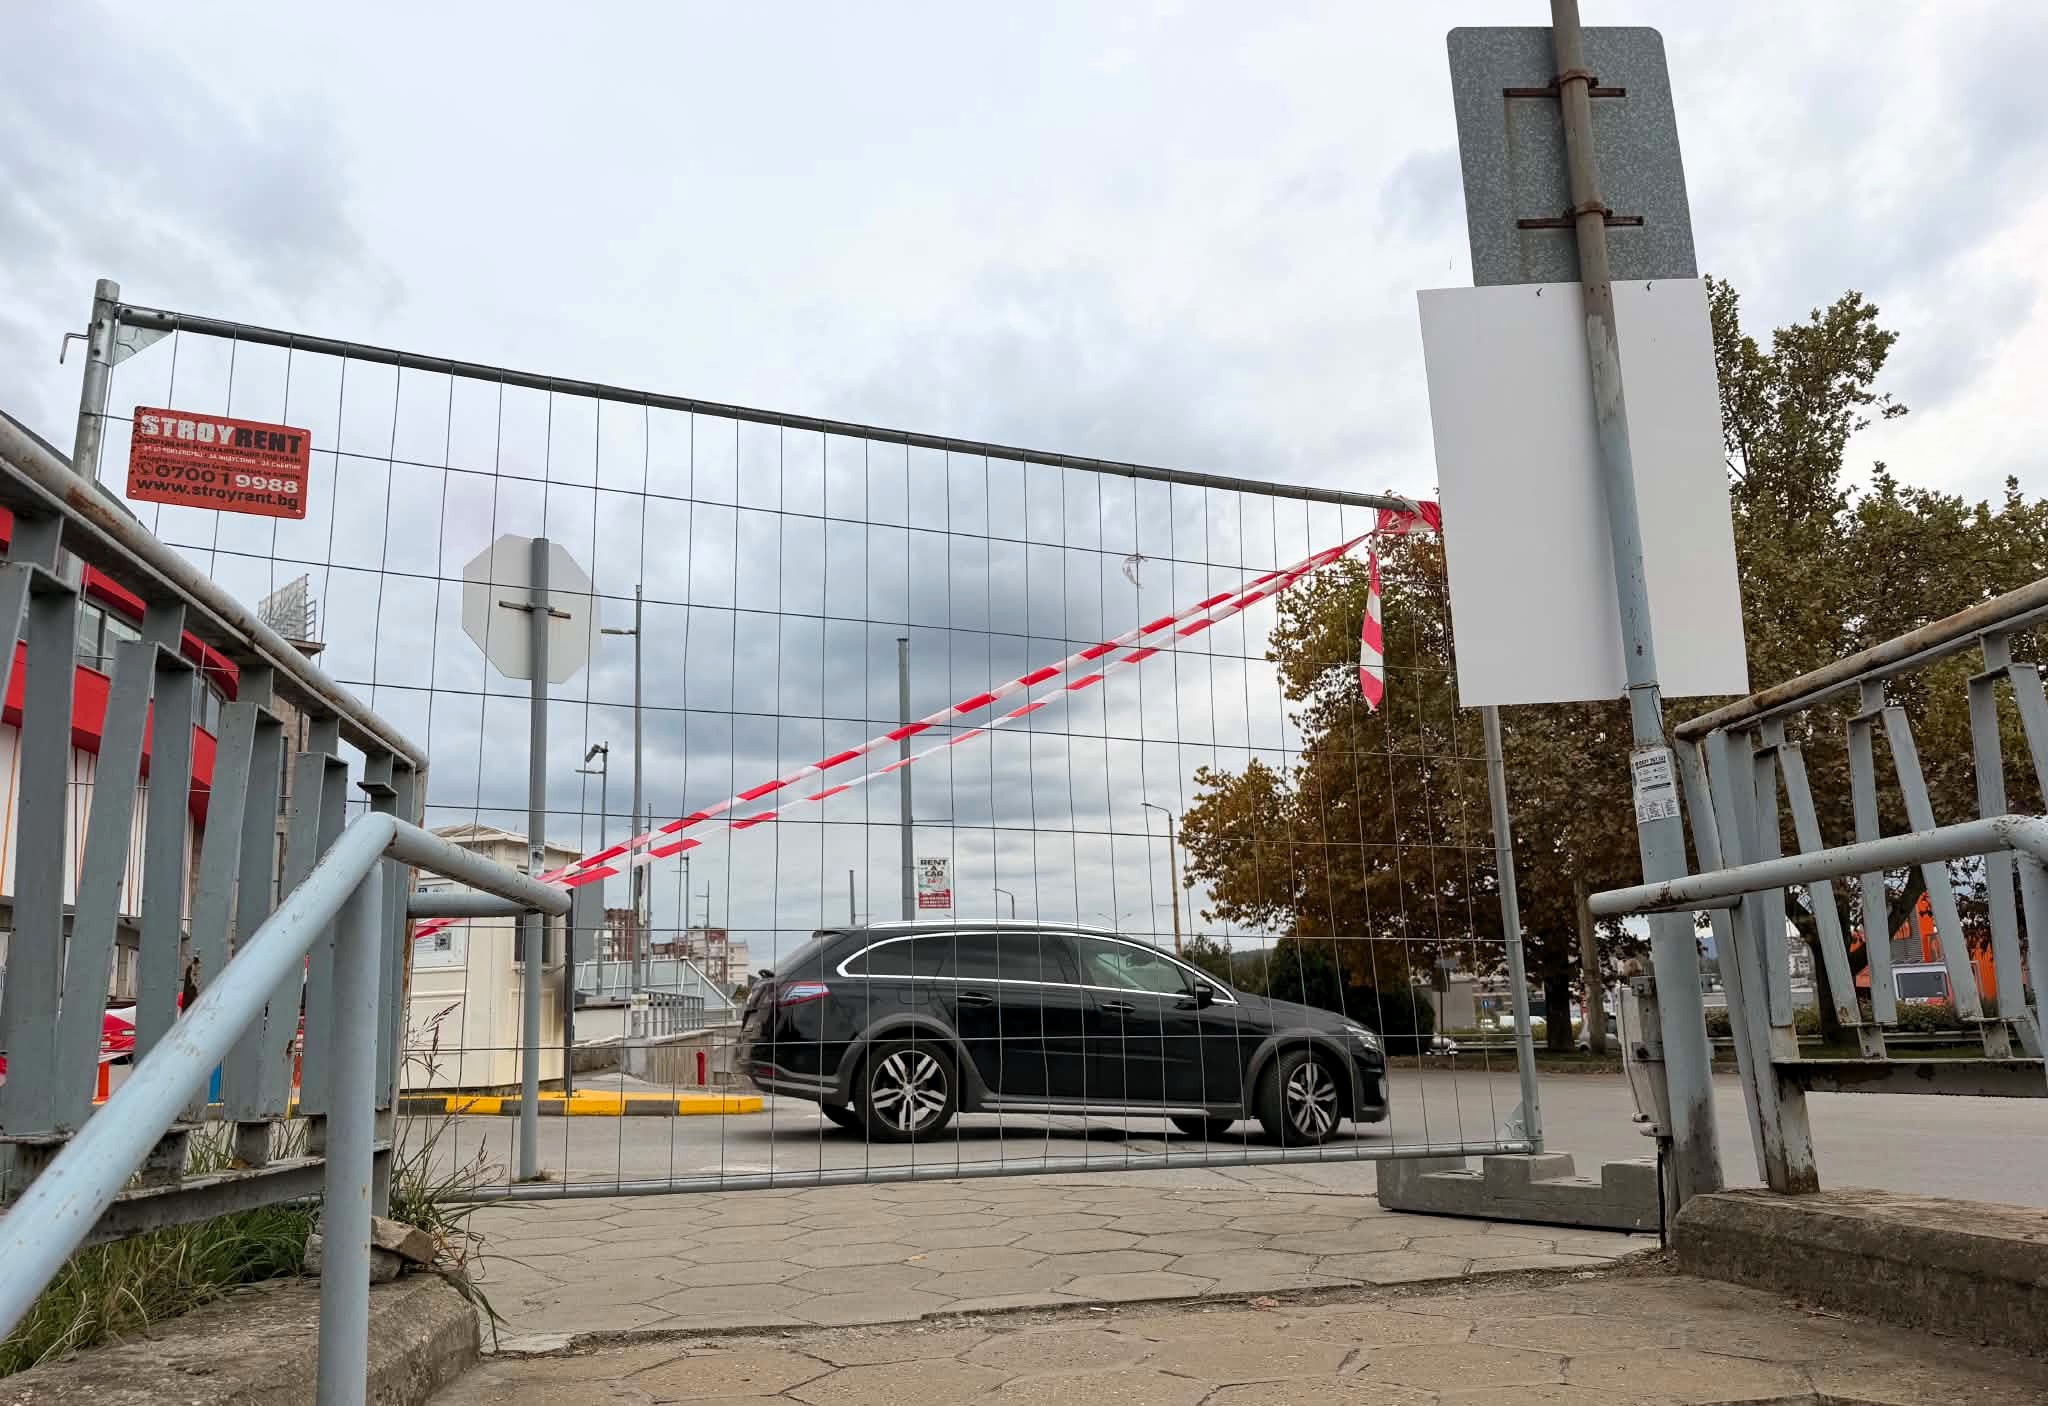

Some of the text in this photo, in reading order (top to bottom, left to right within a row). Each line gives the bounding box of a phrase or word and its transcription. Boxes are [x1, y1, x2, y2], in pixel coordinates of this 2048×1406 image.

[140, 414, 301, 453] STROYRENT
[136, 479, 299, 509] www.stroyrent.bg
[155, 464, 216, 483] 0700
[234, 473, 298, 494] 9988
